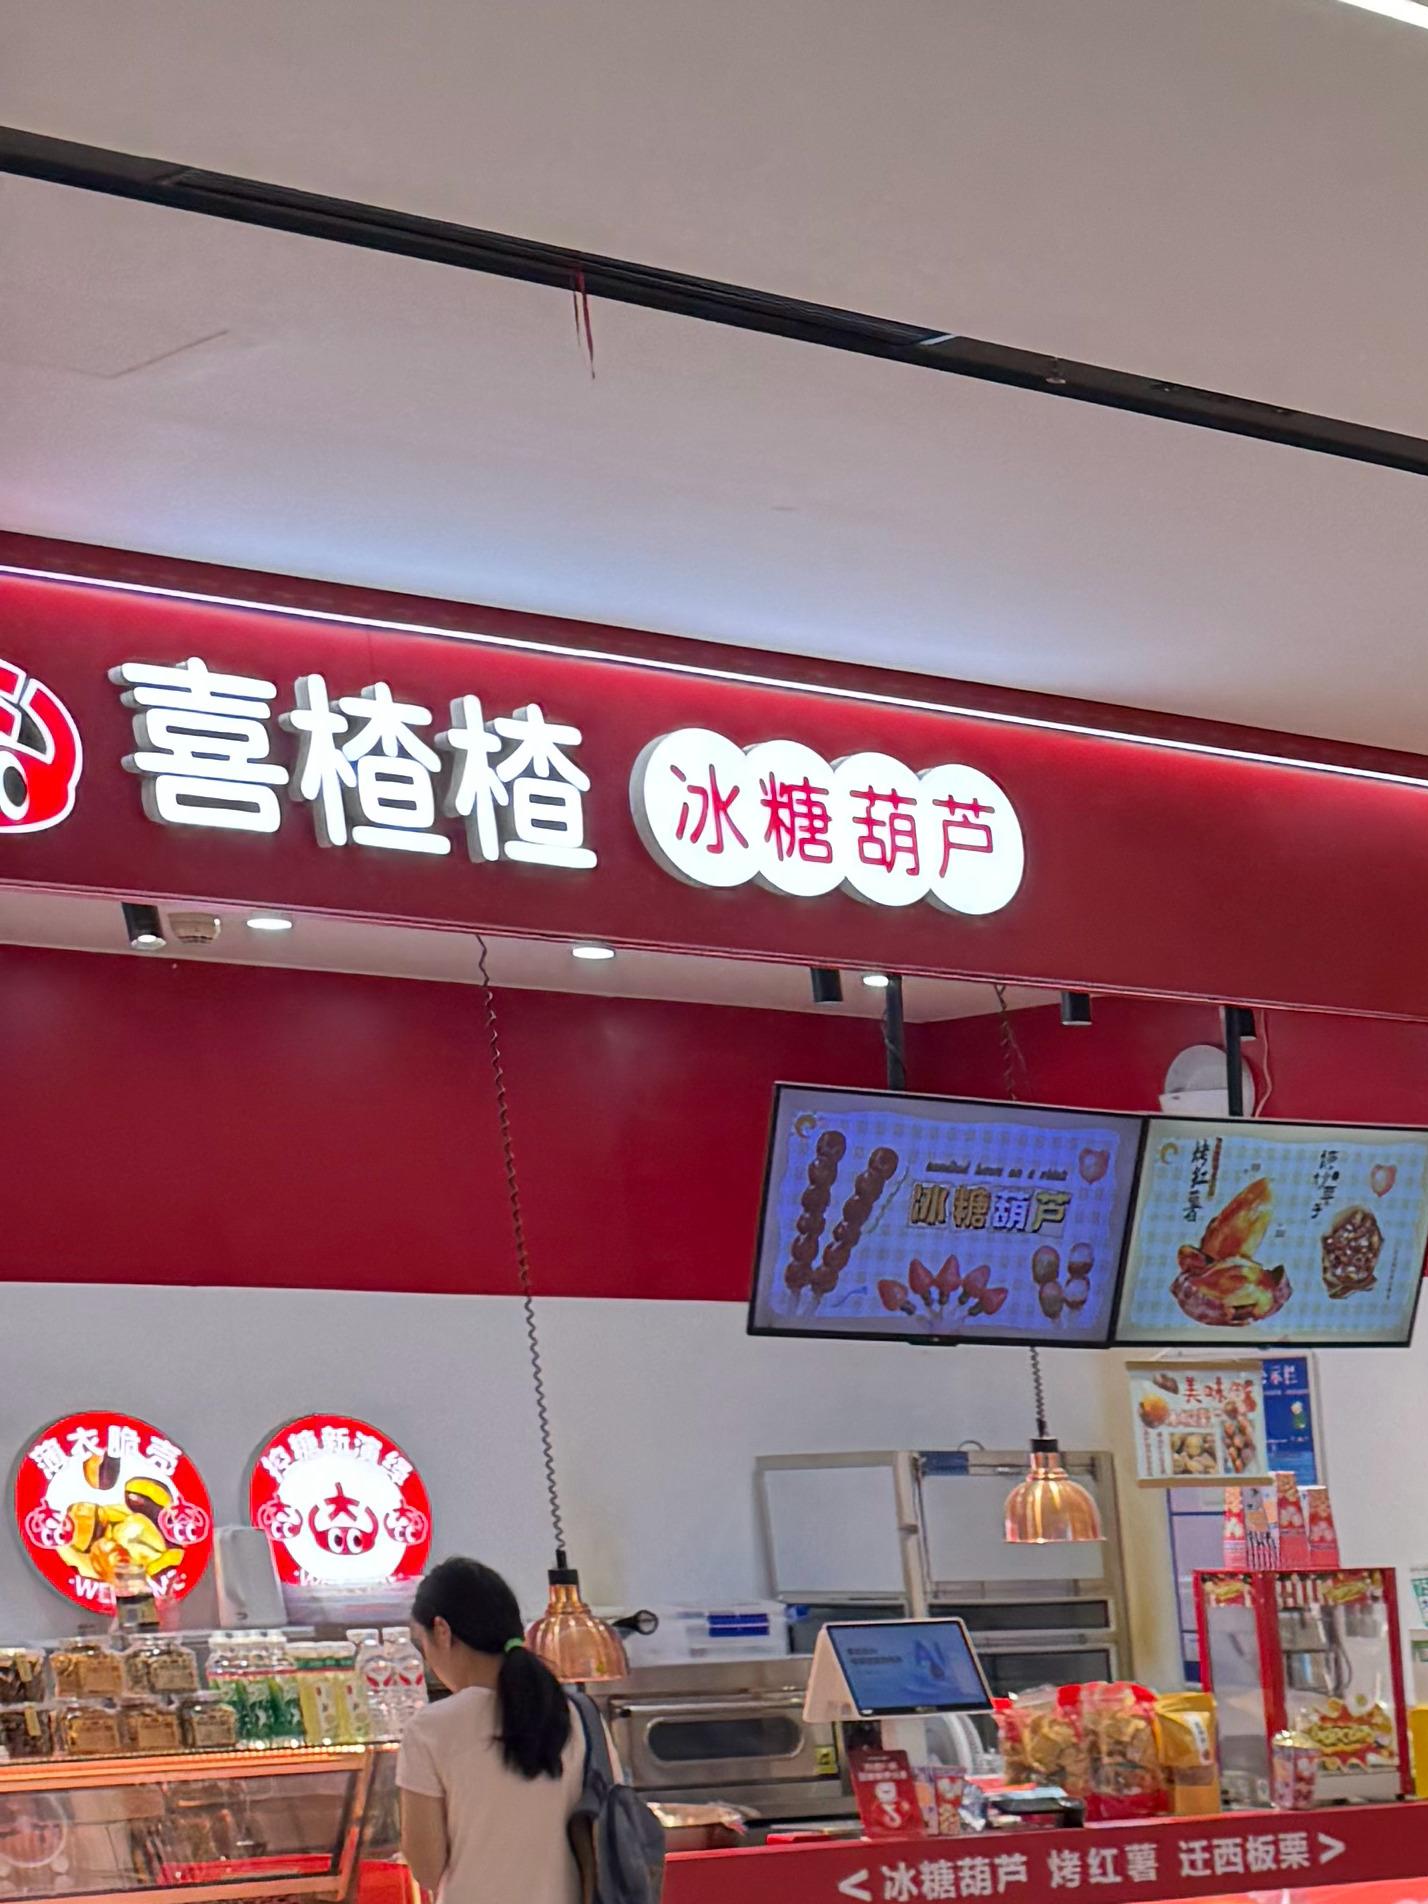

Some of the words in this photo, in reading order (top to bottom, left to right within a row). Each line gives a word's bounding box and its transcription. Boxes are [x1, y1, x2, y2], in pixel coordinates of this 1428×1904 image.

[116, 656, 598, 870] 喜楂楂
[671, 760, 997, 880] 冰糖葫芦
[911, 1182, 1073, 1235] 冰糖葫芦
[881, 1854, 1030, 1903] 冰糖葫芦
[1047, 1843, 1160, 1889] 烤红薯
[1178, 1831, 1310, 1879] 迁西板栗
